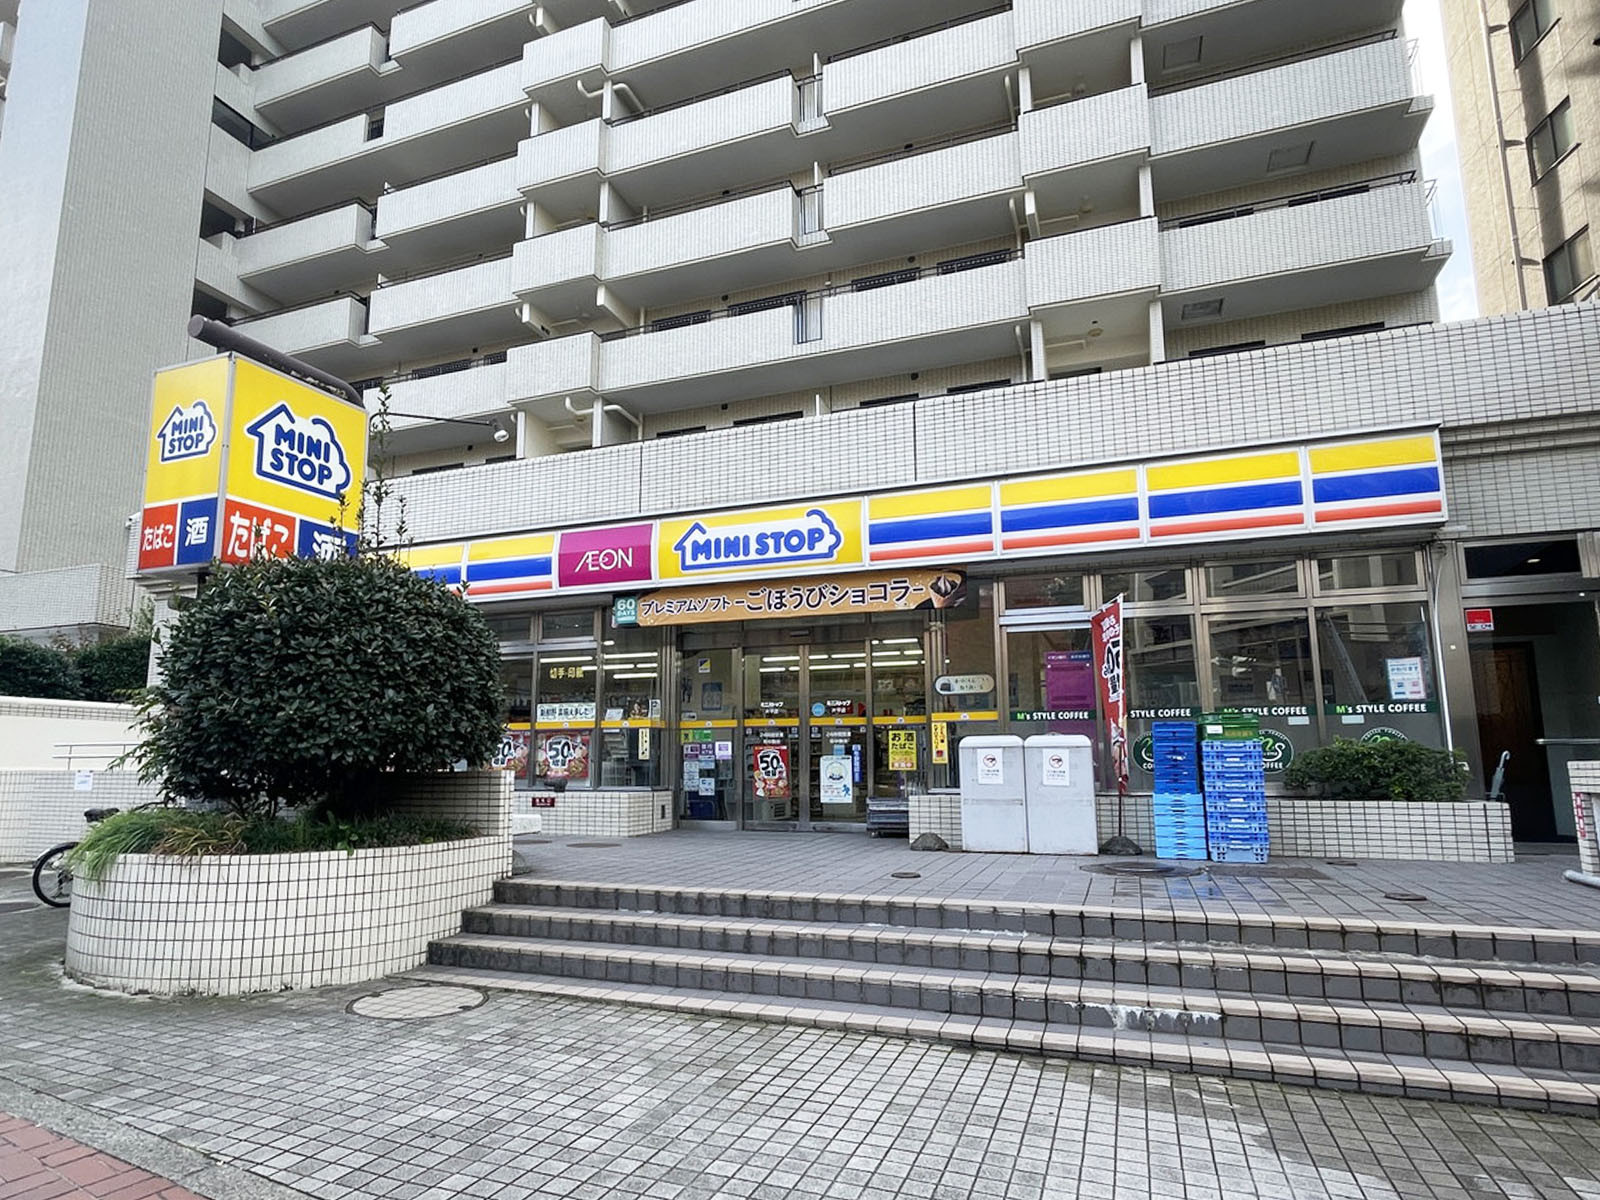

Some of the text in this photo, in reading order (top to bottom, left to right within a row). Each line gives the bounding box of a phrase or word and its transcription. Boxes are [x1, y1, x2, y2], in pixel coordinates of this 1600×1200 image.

[171, 415, 204, 437] MINI
[168, 432, 205, 454] STOP
[275, 423, 331, 463] MINI
[269, 447, 332, 486] STOP
[142, 523, 174, 552] たばこ
[185, 516, 209, 546] 酒
[227, 510, 290, 563] たばこ
[690, 527, 825, 561] MINI STOP
[617, 599, 635, 611] 60
[1017, 711, 1089, 720] M's STYLE COFFEE
[1130, 708, 1191, 718] STYLE COFFEE
[1271, 706, 1308, 715] COFFEE
[1336, 703, 1427, 714] M's STYLE COFFEE
[891, 732, 914, 742] お酒
[891, 742, 914, 750] たばこ
